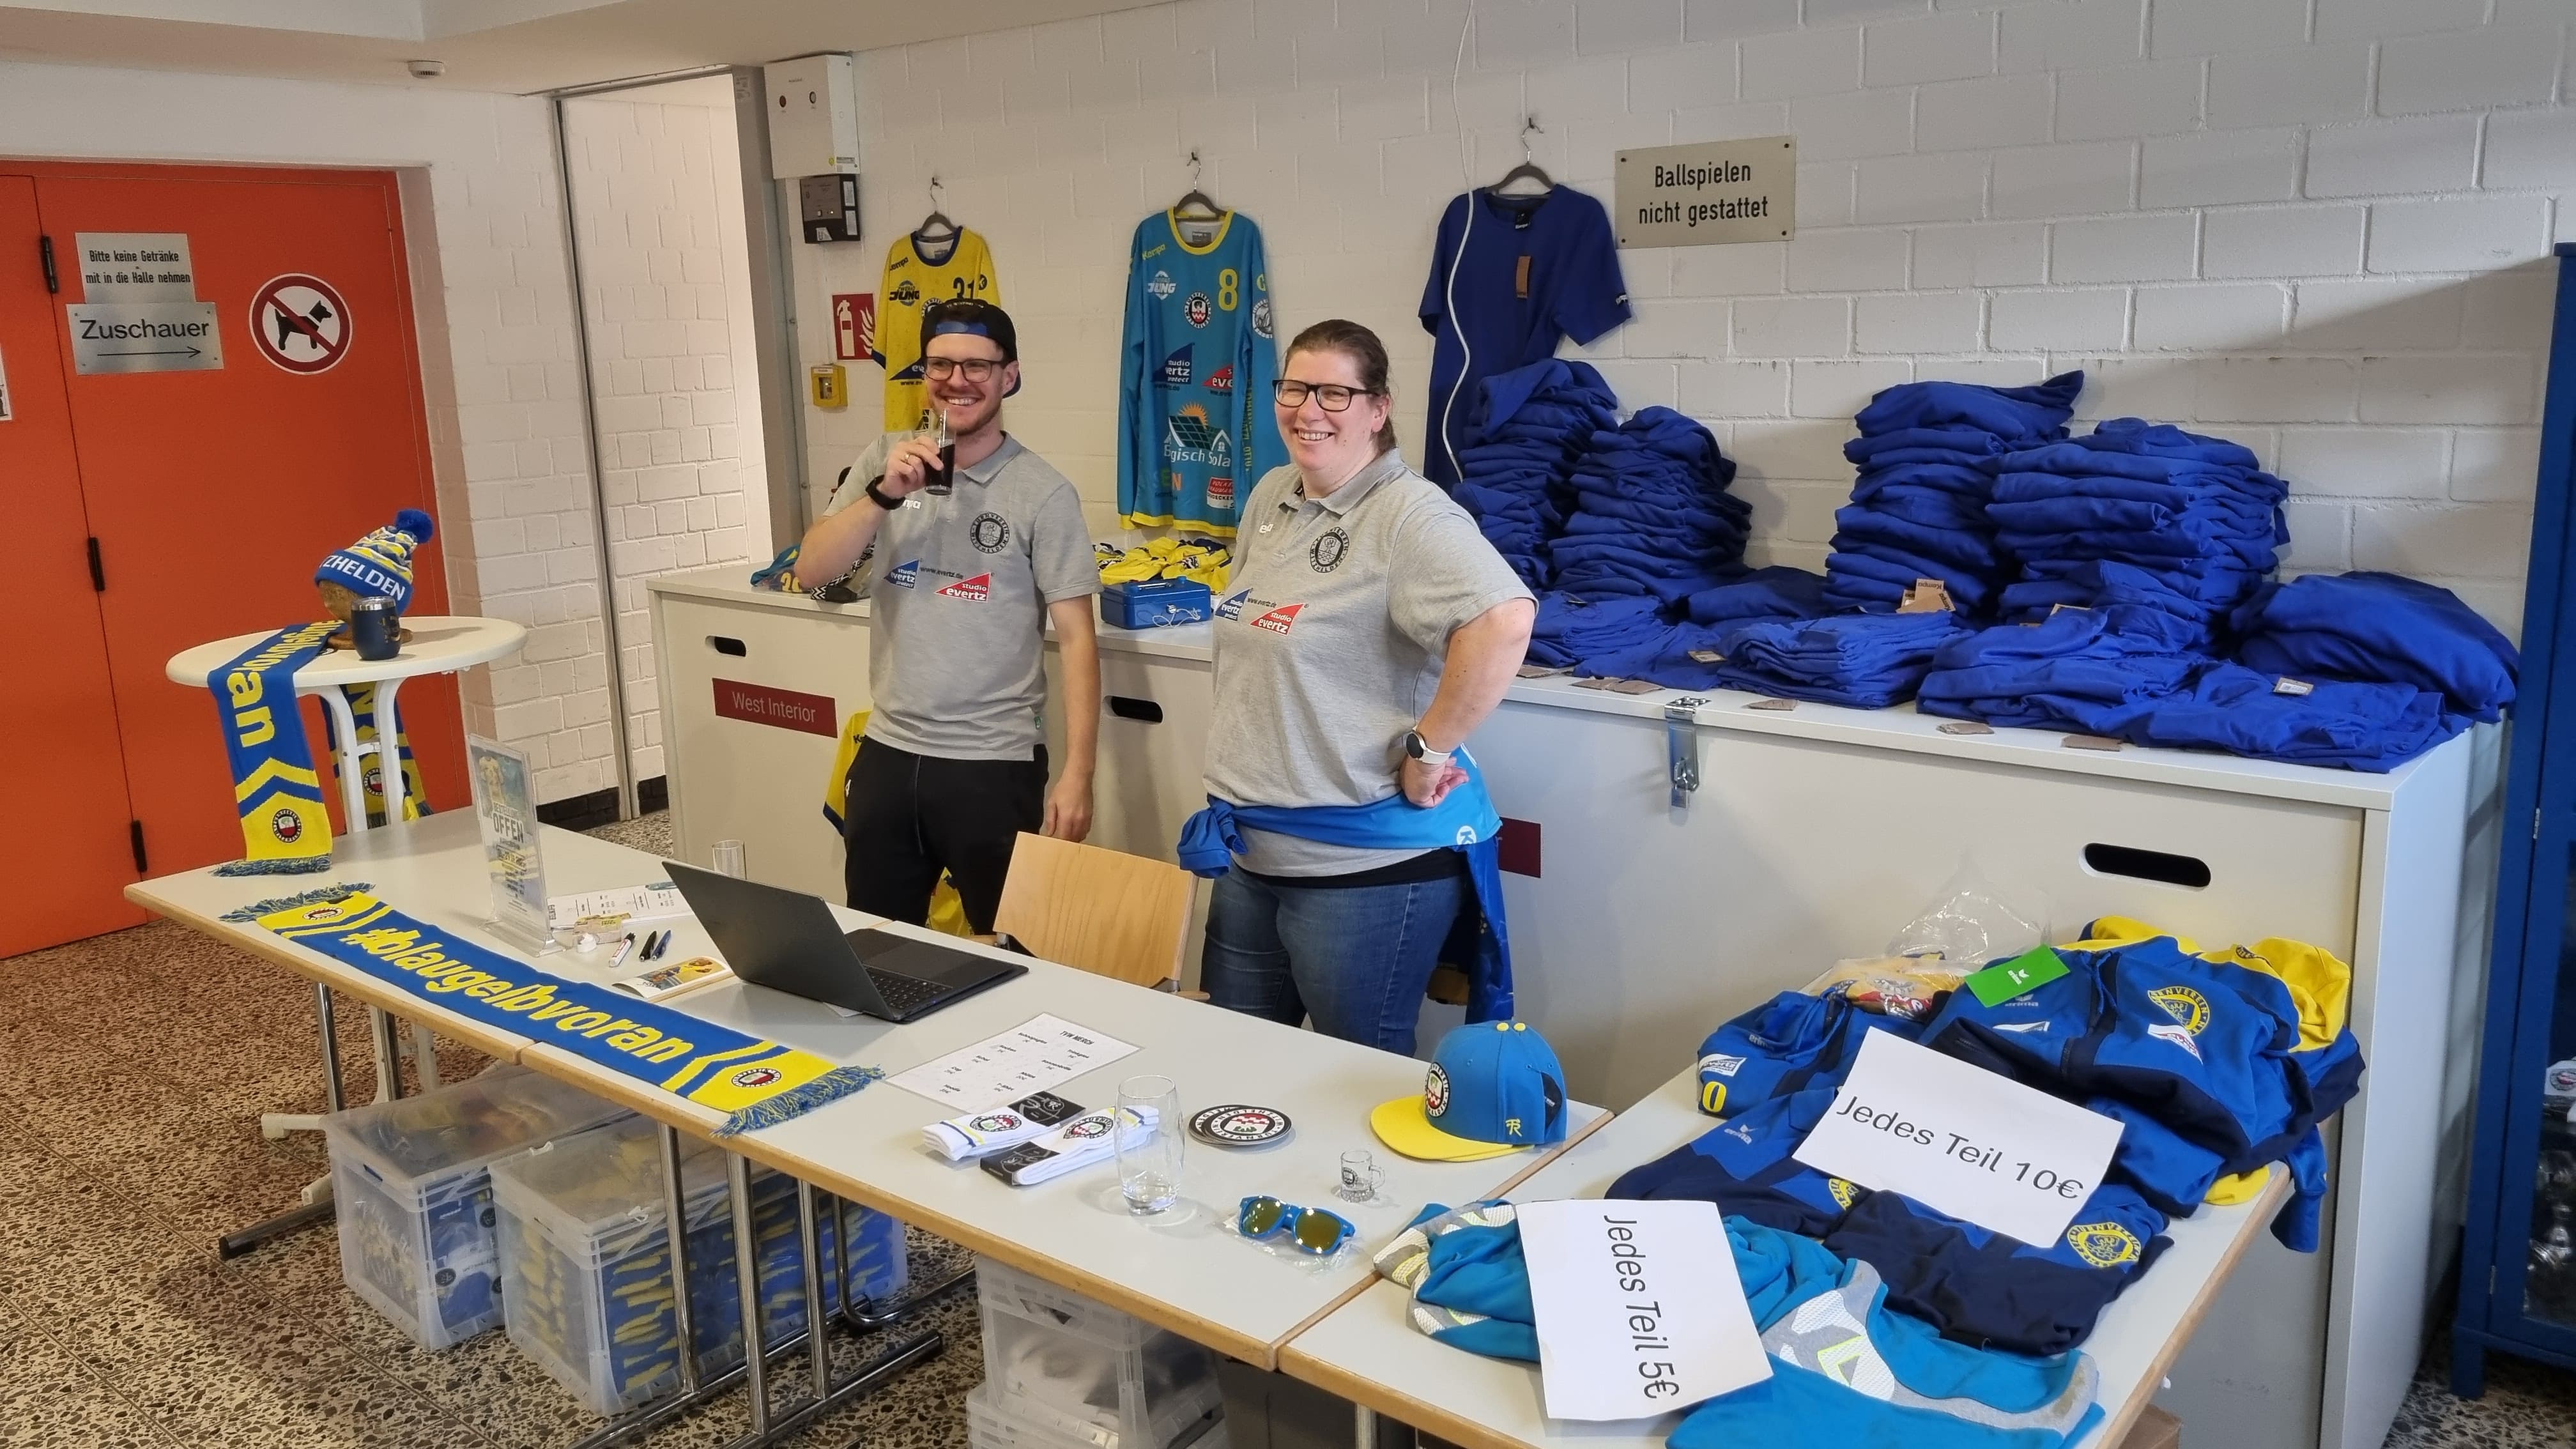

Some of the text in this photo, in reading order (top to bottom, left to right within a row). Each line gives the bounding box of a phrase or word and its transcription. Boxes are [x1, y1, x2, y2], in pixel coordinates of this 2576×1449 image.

[1655, 160, 1751, 191] Ballspielen
[1639, 195, 1768, 227] nicht gestattet
[89, 250, 179, 262] Bitte keine Getränke
[1142, 244, 1166, 260] Kempa
[86, 272, 190, 284] mit in die Halle nehmen
[889, 290, 920, 301] JUNG
[1147, 283, 1176, 293] JUNG
[1218, 268, 1238, 311] 8
[80, 319, 209, 339] Zuschauer
[891, 572, 916, 583] evertz
[946, 588, 986, 601] evertz
[1222, 604, 1240, 615] evertz
[1271, 611, 1292, 622] studio
[1259, 618, 1289, 633] evertz
[732, 691, 816, 723] West Interior
[493, 813, 524, 843] OFFEN
[338, 928, 694, 1063] #blaugelbvoran
[1836, 1095, 2084, 1199] Jedes Teil 10€
[1603, 1215, 1680, 1399] Jedes Teil 5€
